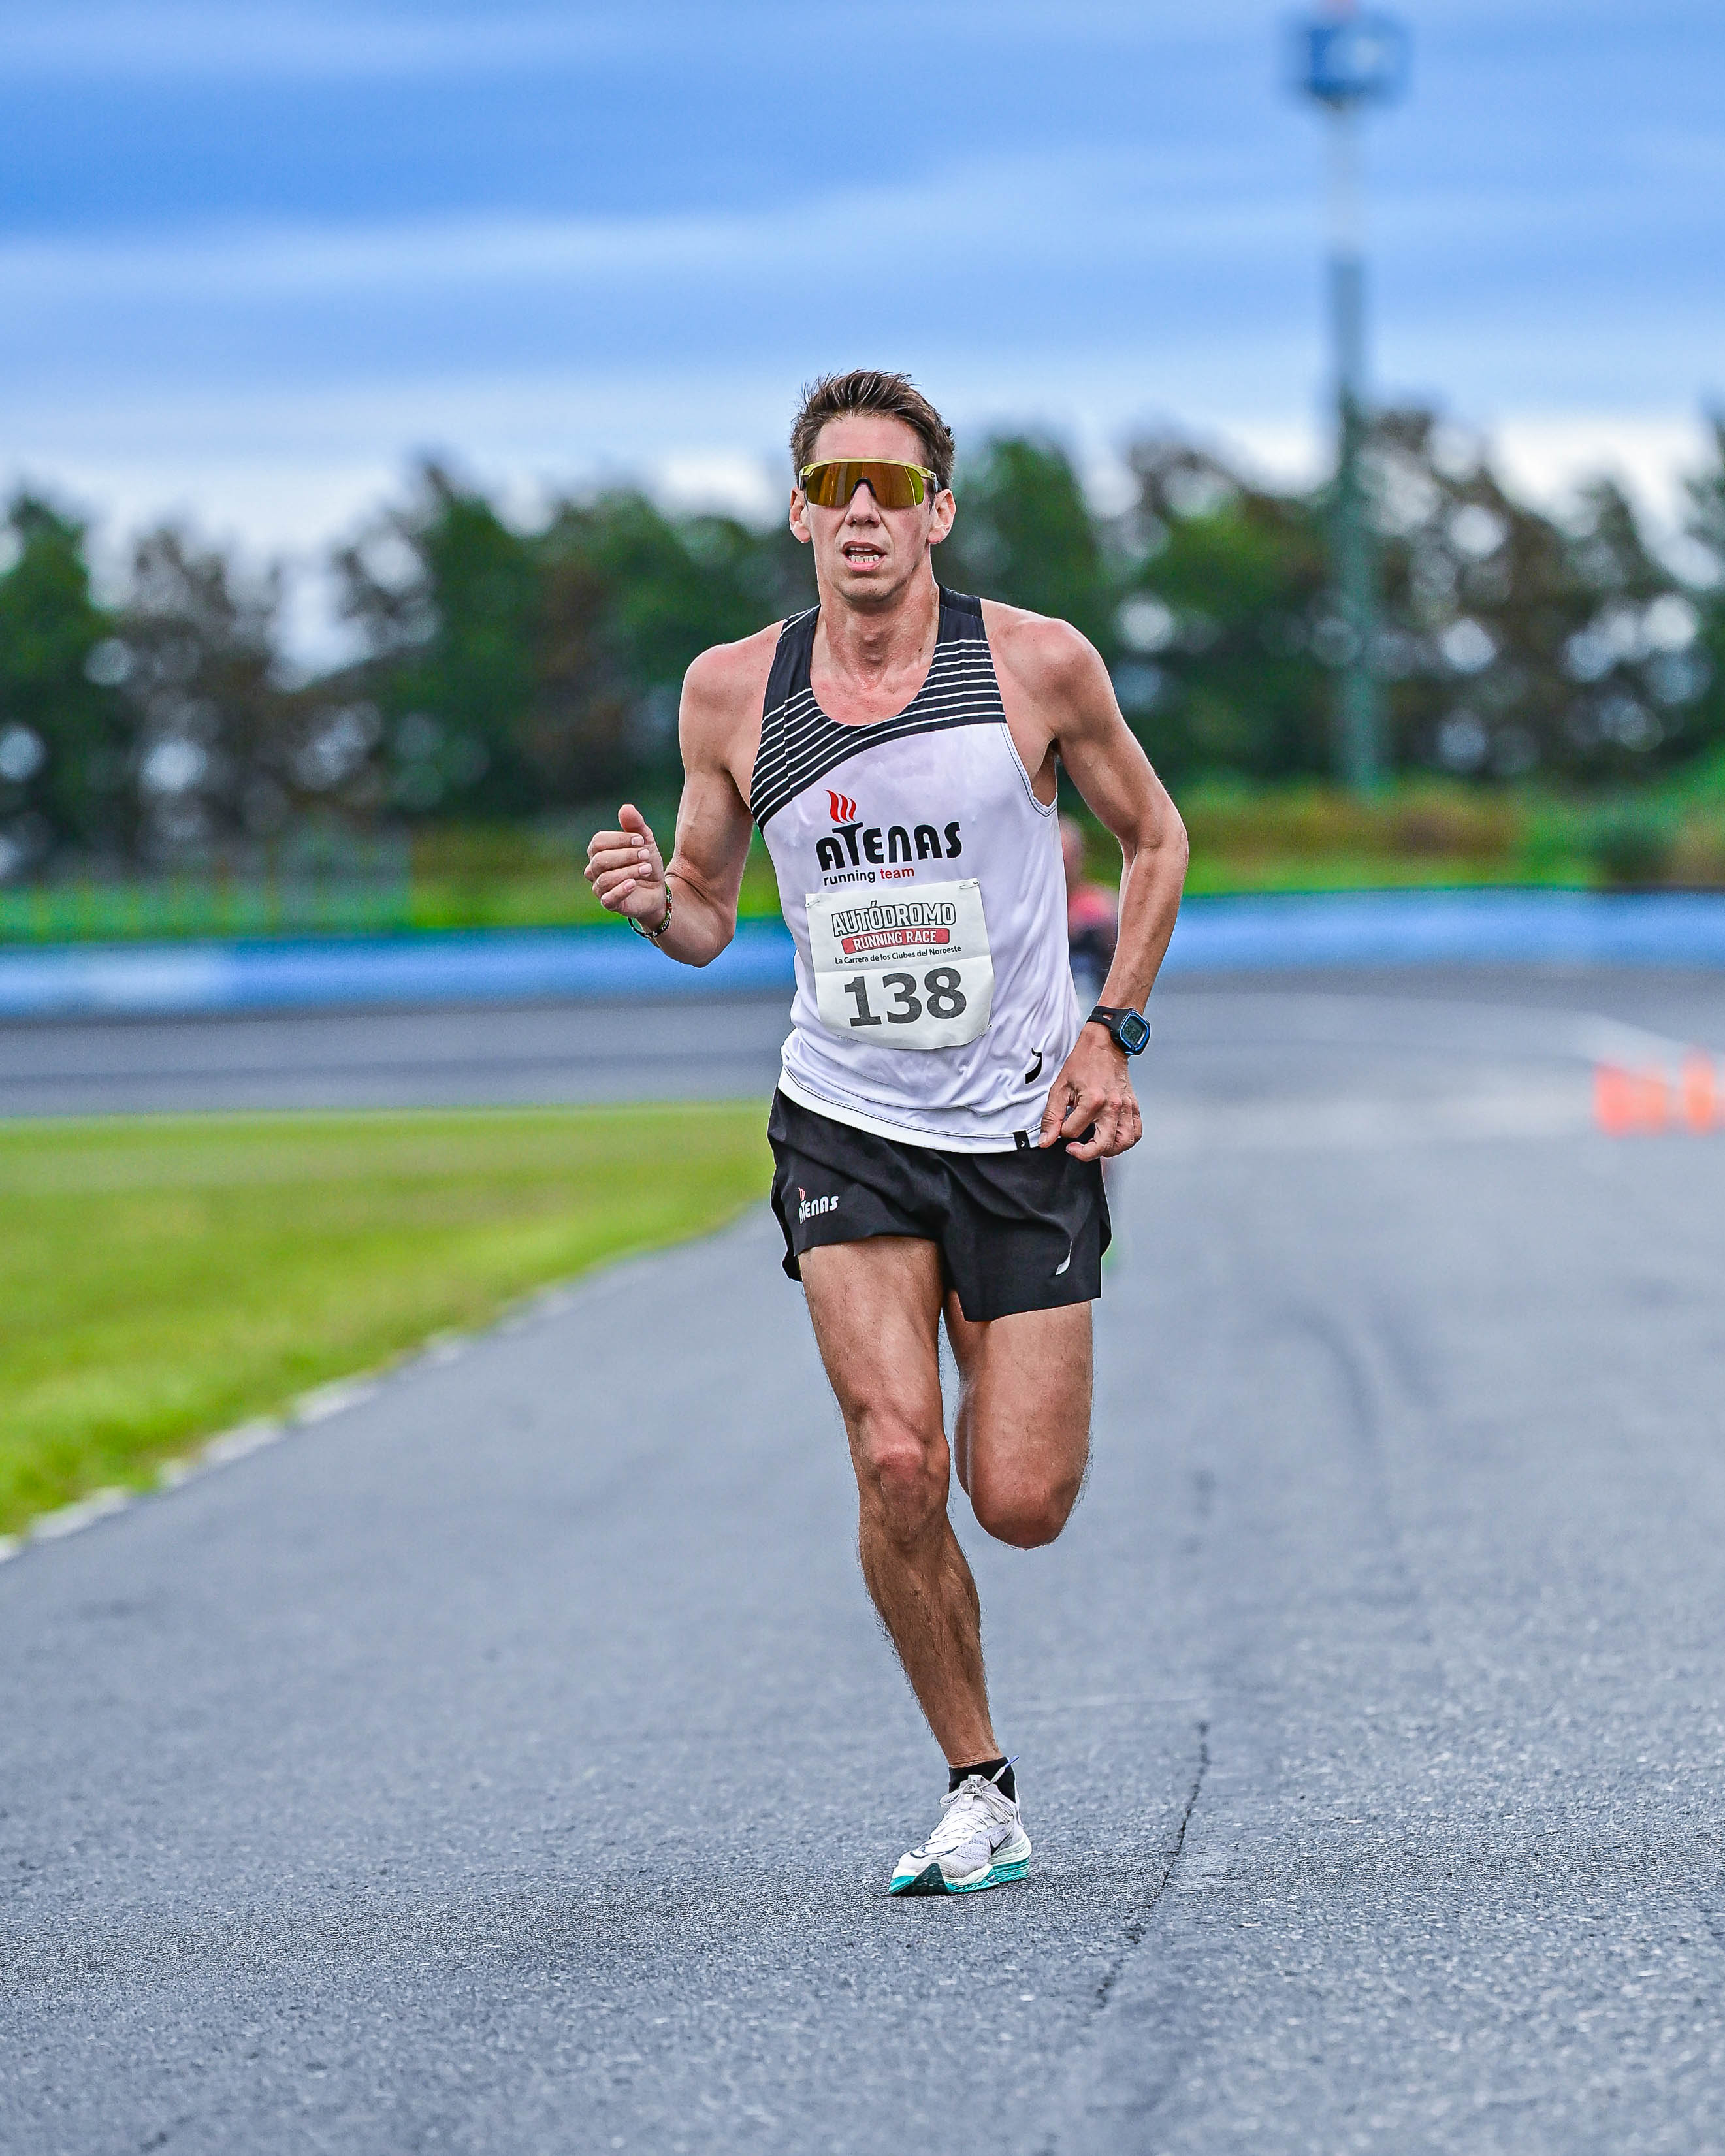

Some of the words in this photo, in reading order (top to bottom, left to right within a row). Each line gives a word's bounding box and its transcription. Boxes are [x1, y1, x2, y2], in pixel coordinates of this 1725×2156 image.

[816, 822, 962, 871] ATENAS
[824, 870, 875, 886] running
[880, 868, 914, 879] team
[831, 901, 956, 937] AUTÓDROMO
[852, 932, 903, 951] RUNNING
[906, 931, 937, 943] RACE
[929, 946, 961, 955] Noroeste
[844, 967, 967, 1027] 138
[799, 1195, 839, 1225] ATENAS
